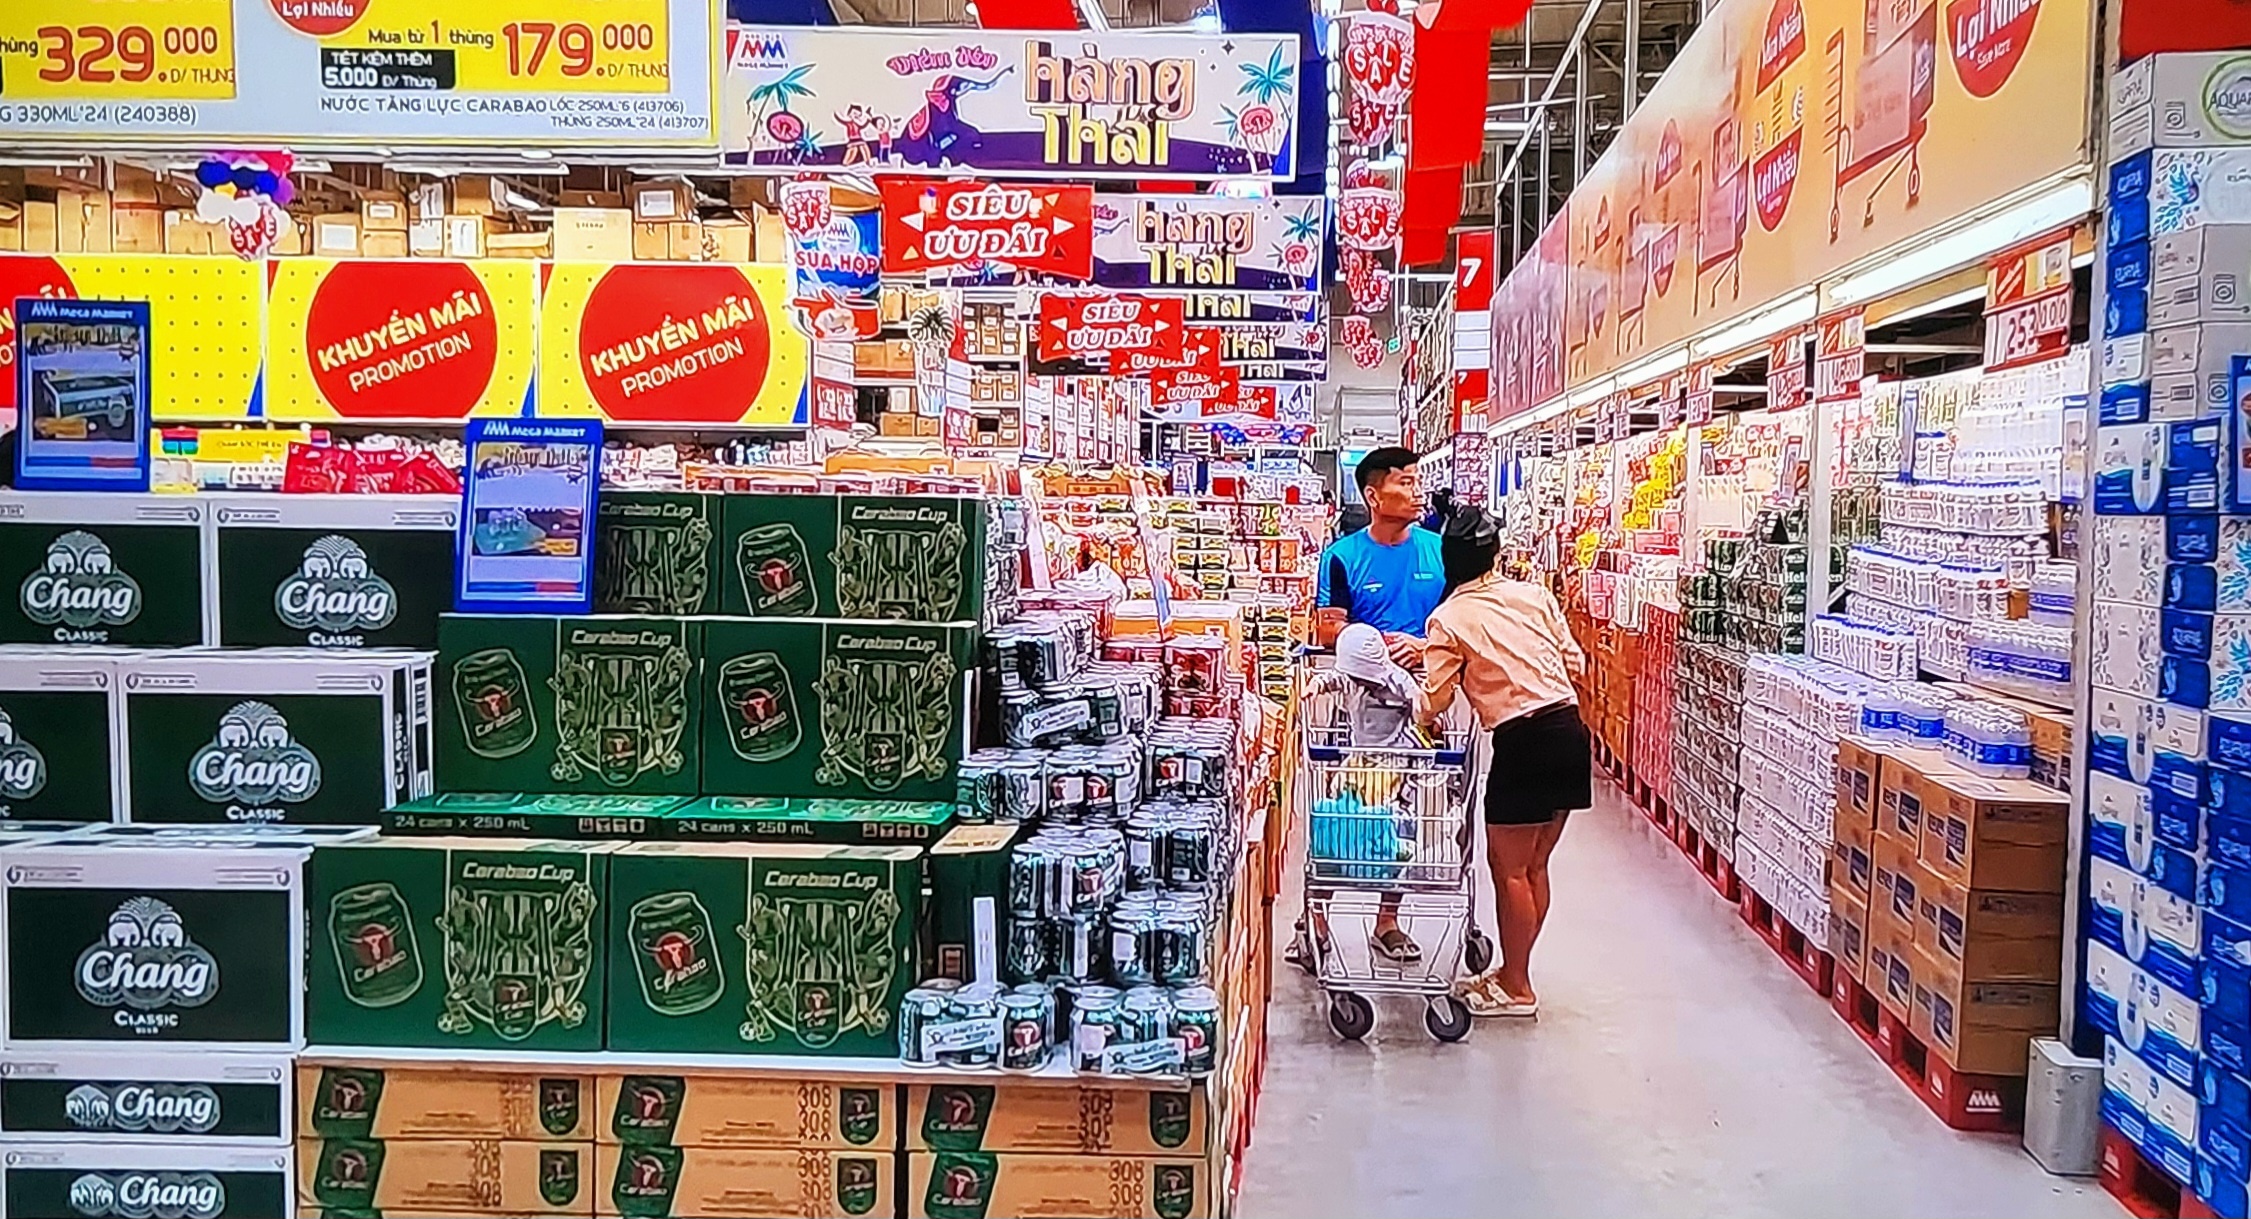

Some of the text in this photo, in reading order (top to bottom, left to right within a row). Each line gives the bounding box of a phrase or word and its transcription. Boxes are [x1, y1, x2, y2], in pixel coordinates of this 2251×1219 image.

[368, 30, 401, 43] Mua
[430, 20, 439, 44] 1
[449, 29, 494, 48] thùng
[324, 67, 378, 87] 5.000
[320, 95, 370, 111] NƯỚC
[375, 95, 421, 112] TĂNG
[466, 99, 547, 113] CARABAO
[948, 185, 1032, 219] SIÊU
[1460, 258, 1482, 288] 7
[429, 290, 483, 329] MÃI
[702, 296, 754, 335] MÃI
[1083, 299, 1141, 322] SIÊU
[348, 331, 472, 393] PROMOTION
[620, 336, 744, 398] PROMOTION
[662, 503, 693, 519] Cup
[917, 507, 948, 523] Cup
[26, 577, 134, 618] Chang
[281, 581, 389, 620] Chang
[639, 631, 672, 648] Cup
[904, 636, 937, 654] Cup
[196, 752, 313, 791] Chang
[756, 822, 787, 835] 250
[539, 864, 576, 883] Cup
[842, 872, 878, 891] Cup
[83, 950, 210, 998] Chang
[114, 1010, 179, 1027] CLASSIC
[115, 1087, 214, 1124] Chang
[799, 1086, 832, 1109] 308
[799, 1111, 832, 1132] 308
[1109, 1160, 1145, 1181] 308
[121, 1176, 218, 1213] Chang
[1109, 1183, 1145, 1206] 308
